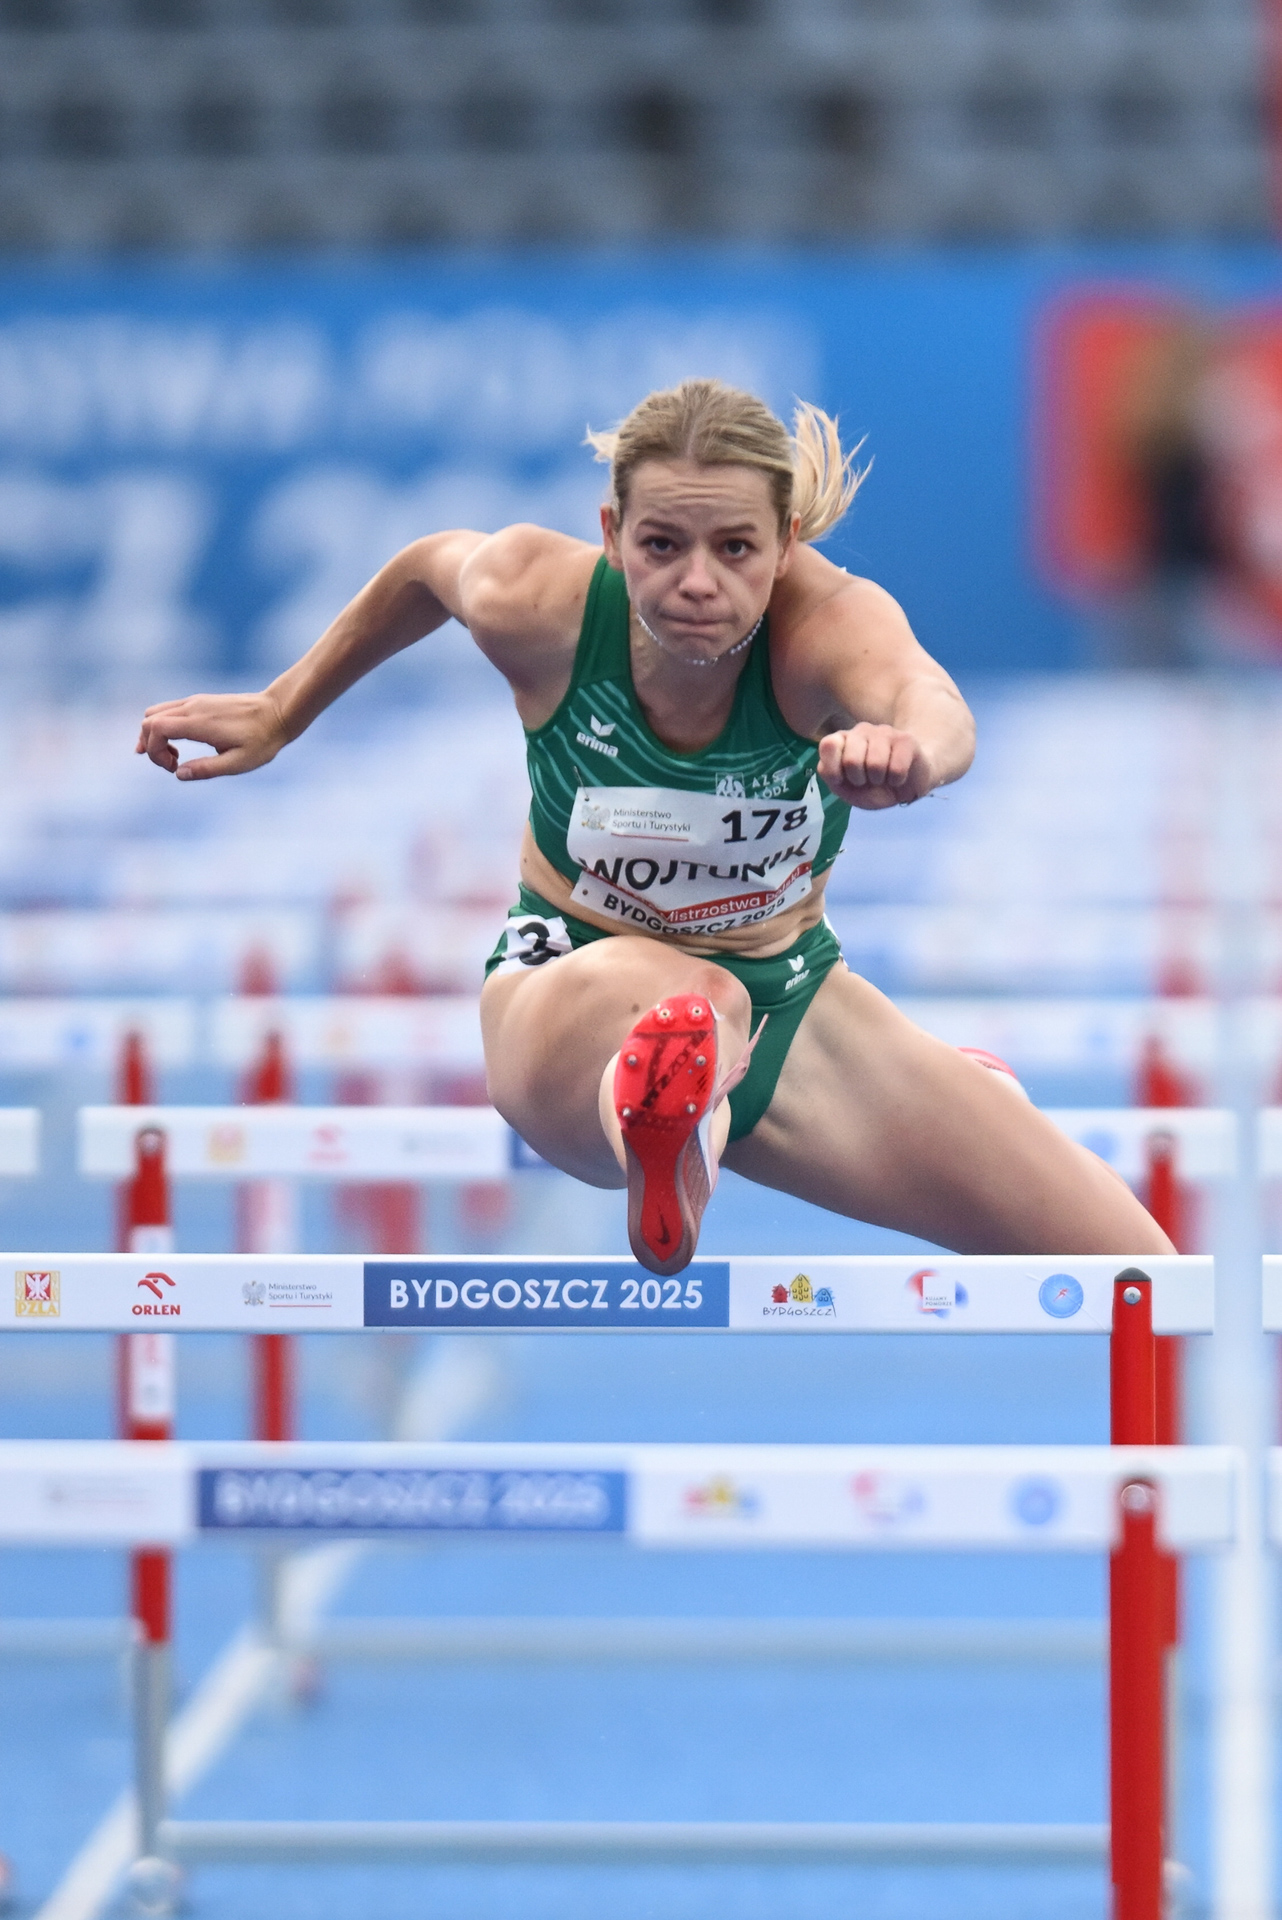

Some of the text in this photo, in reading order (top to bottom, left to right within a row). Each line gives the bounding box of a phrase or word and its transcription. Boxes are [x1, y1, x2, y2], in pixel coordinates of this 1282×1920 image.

[576, 731, 619, 758] erima
[613, 808, 672, 819] Ministerstwo
[612, 820, 642, 830] Sportu
[650, 822, 691, 832] Turystyki
[721, 805, 808, 843] 178
[603, 893, 736, 934] BYDGOSZCZ
[518, 921, 562, 965] 3
[268, 1292, 293, 1300] Sportu
[299, 1292, 333, 1300] Turystyki
[390, 1279, 703, 1309] BYDGOSZCZ 2025
[17, 1301, 58, 1315] PZLA
[132, 1304, 180, 1315] ORLEN
[762, 1306, 837, 1317] BYDGOSZCZ
